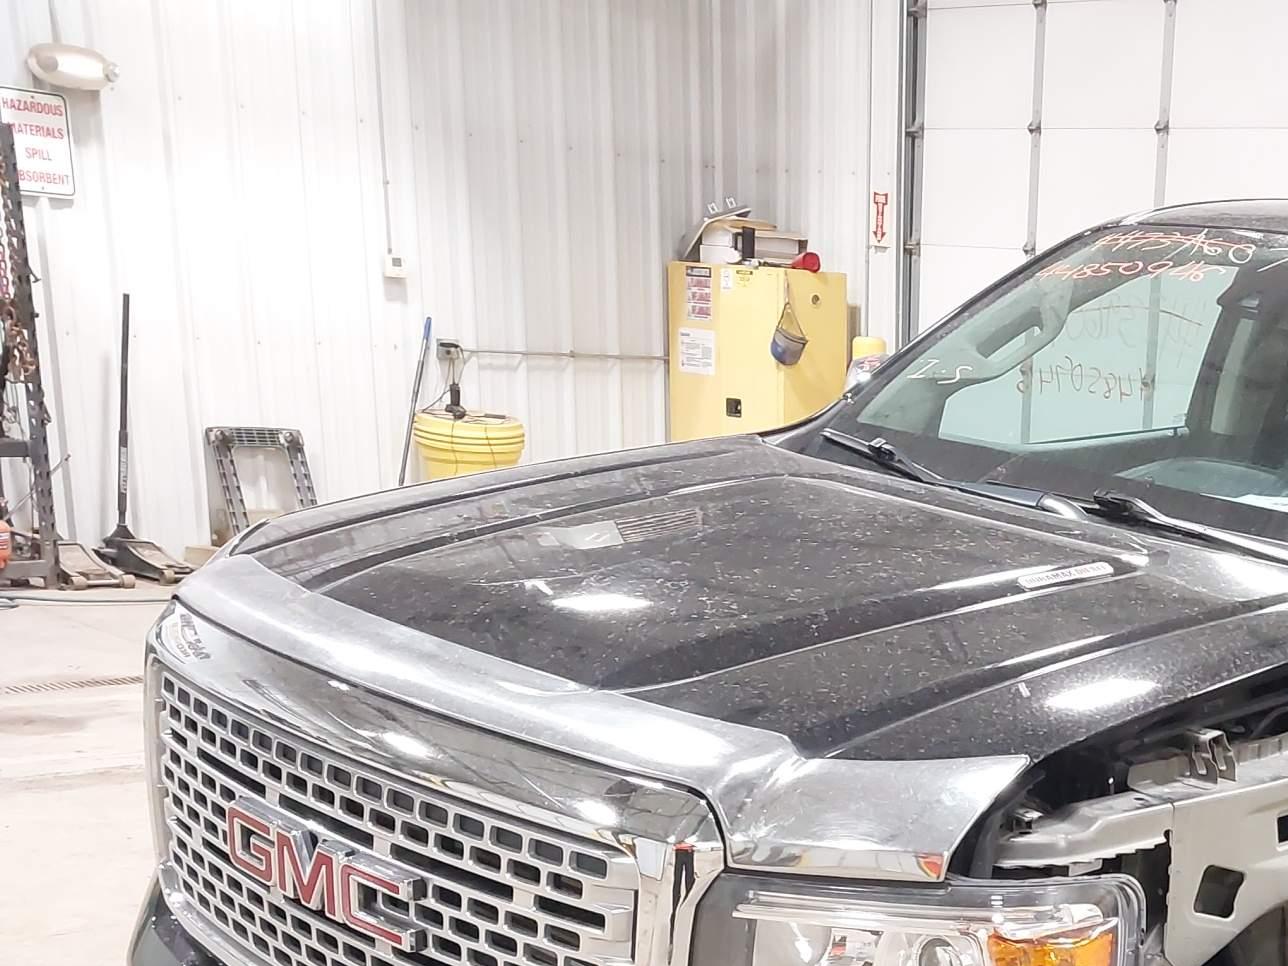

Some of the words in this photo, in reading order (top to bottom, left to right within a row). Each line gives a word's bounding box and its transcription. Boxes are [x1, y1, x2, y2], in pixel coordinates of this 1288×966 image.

[2, 98, 64, 117] HAZARDOUS
[25, 146, 53, 161] SPILL
[17, 168, 70, 186] BSORBENT
[227, 800, 424, 951] GMC
